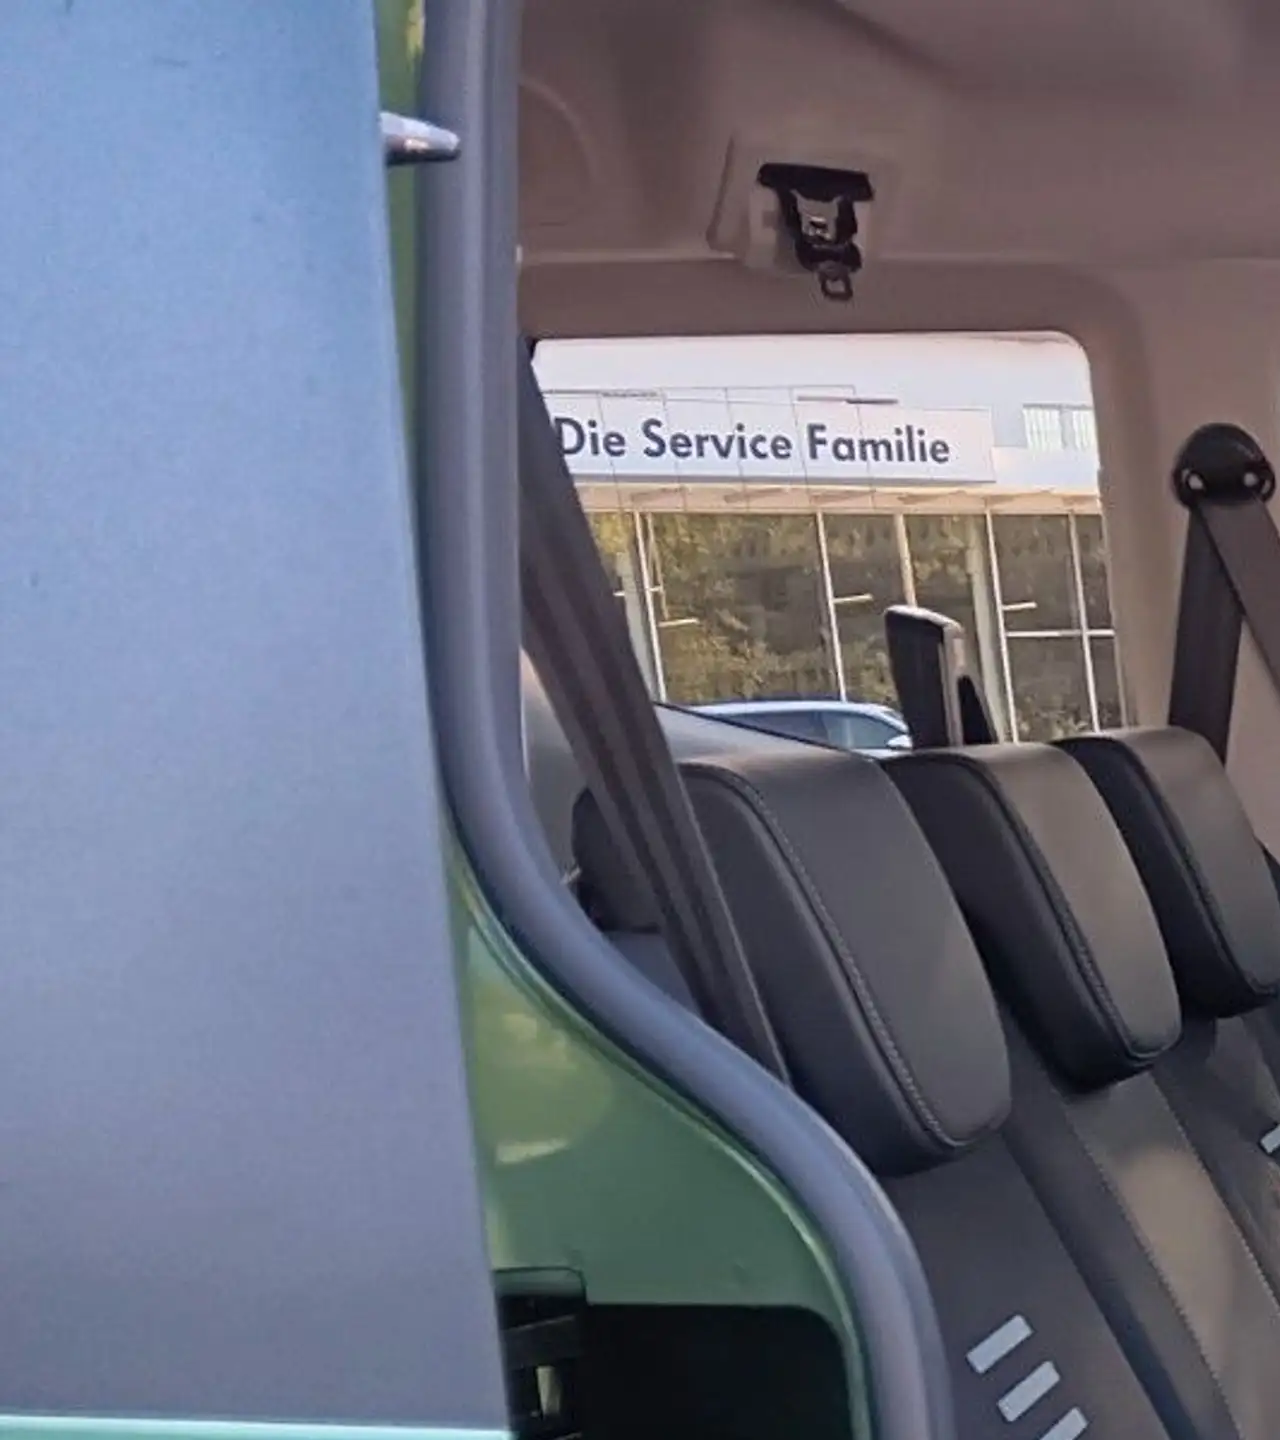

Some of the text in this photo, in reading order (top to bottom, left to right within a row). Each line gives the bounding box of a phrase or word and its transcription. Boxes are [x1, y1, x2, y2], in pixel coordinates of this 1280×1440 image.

[553, 416, 950, 464] Die Service Familie
